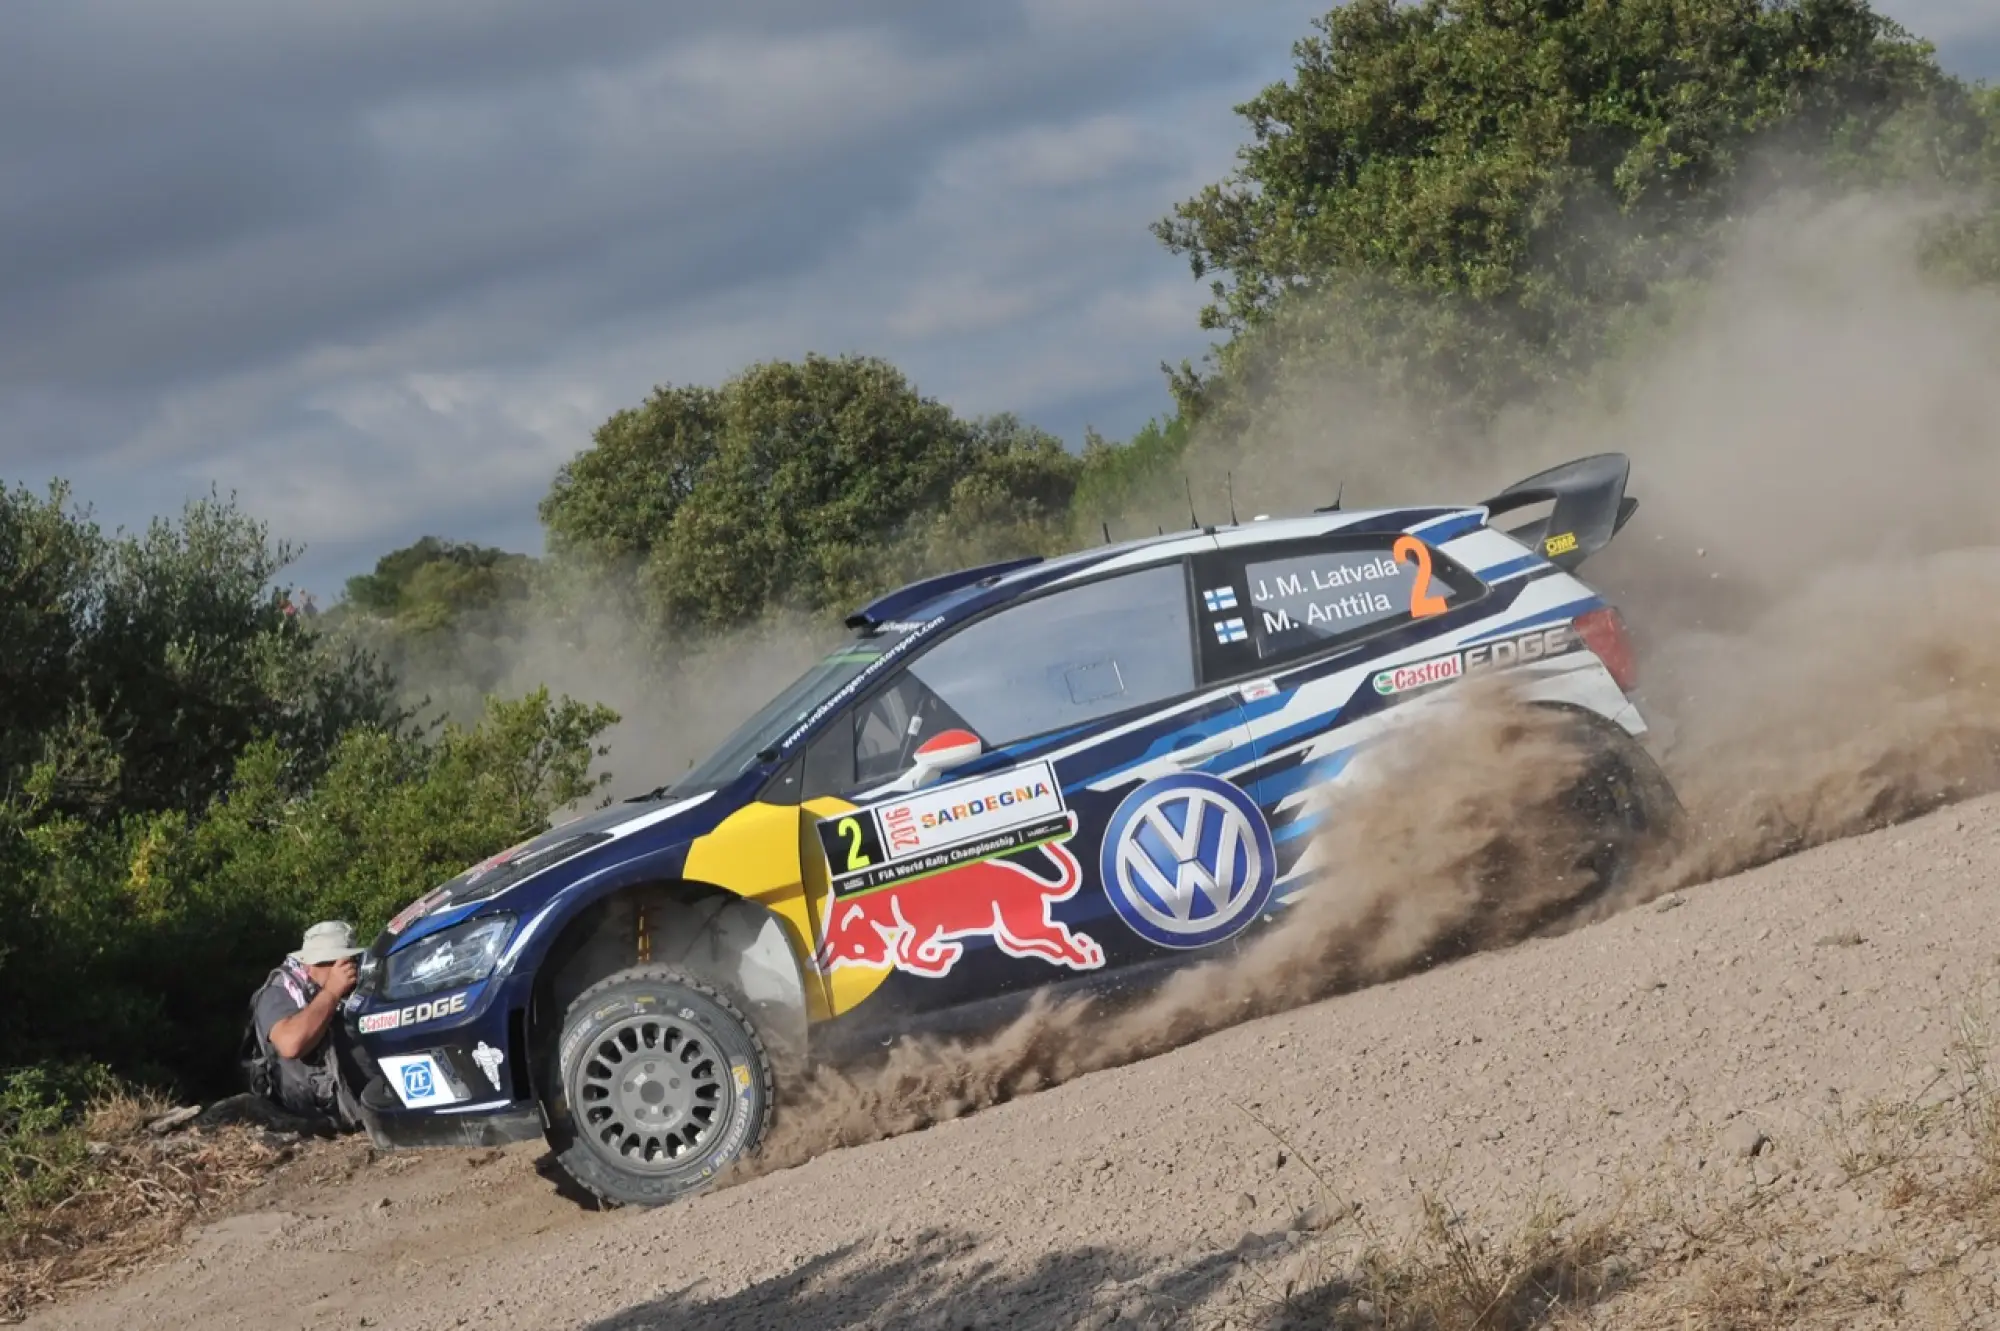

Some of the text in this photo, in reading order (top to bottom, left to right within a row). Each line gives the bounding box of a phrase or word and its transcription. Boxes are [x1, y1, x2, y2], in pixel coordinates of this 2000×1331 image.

[1545, 534, 1576, 553] OMP
[1254, 557, 1400, 602] J. M. Latvala
[1392, 535, 1448, 618] 2
[1262, 591, 1392, 634] M. Anttila
[1394, 625, 1571, 691] Castrol EDGE
[920, 781, 1050, 829] SARDEGNA
[838, 817, 870, 871] 2
[885, 807, 920, 851] 2016
[878, 836, 1016, 881] FIA World Rally Championship
[363, 991, 468, 1032] Castrol EDGE
[405, 1067, 431, 1093] ZF
